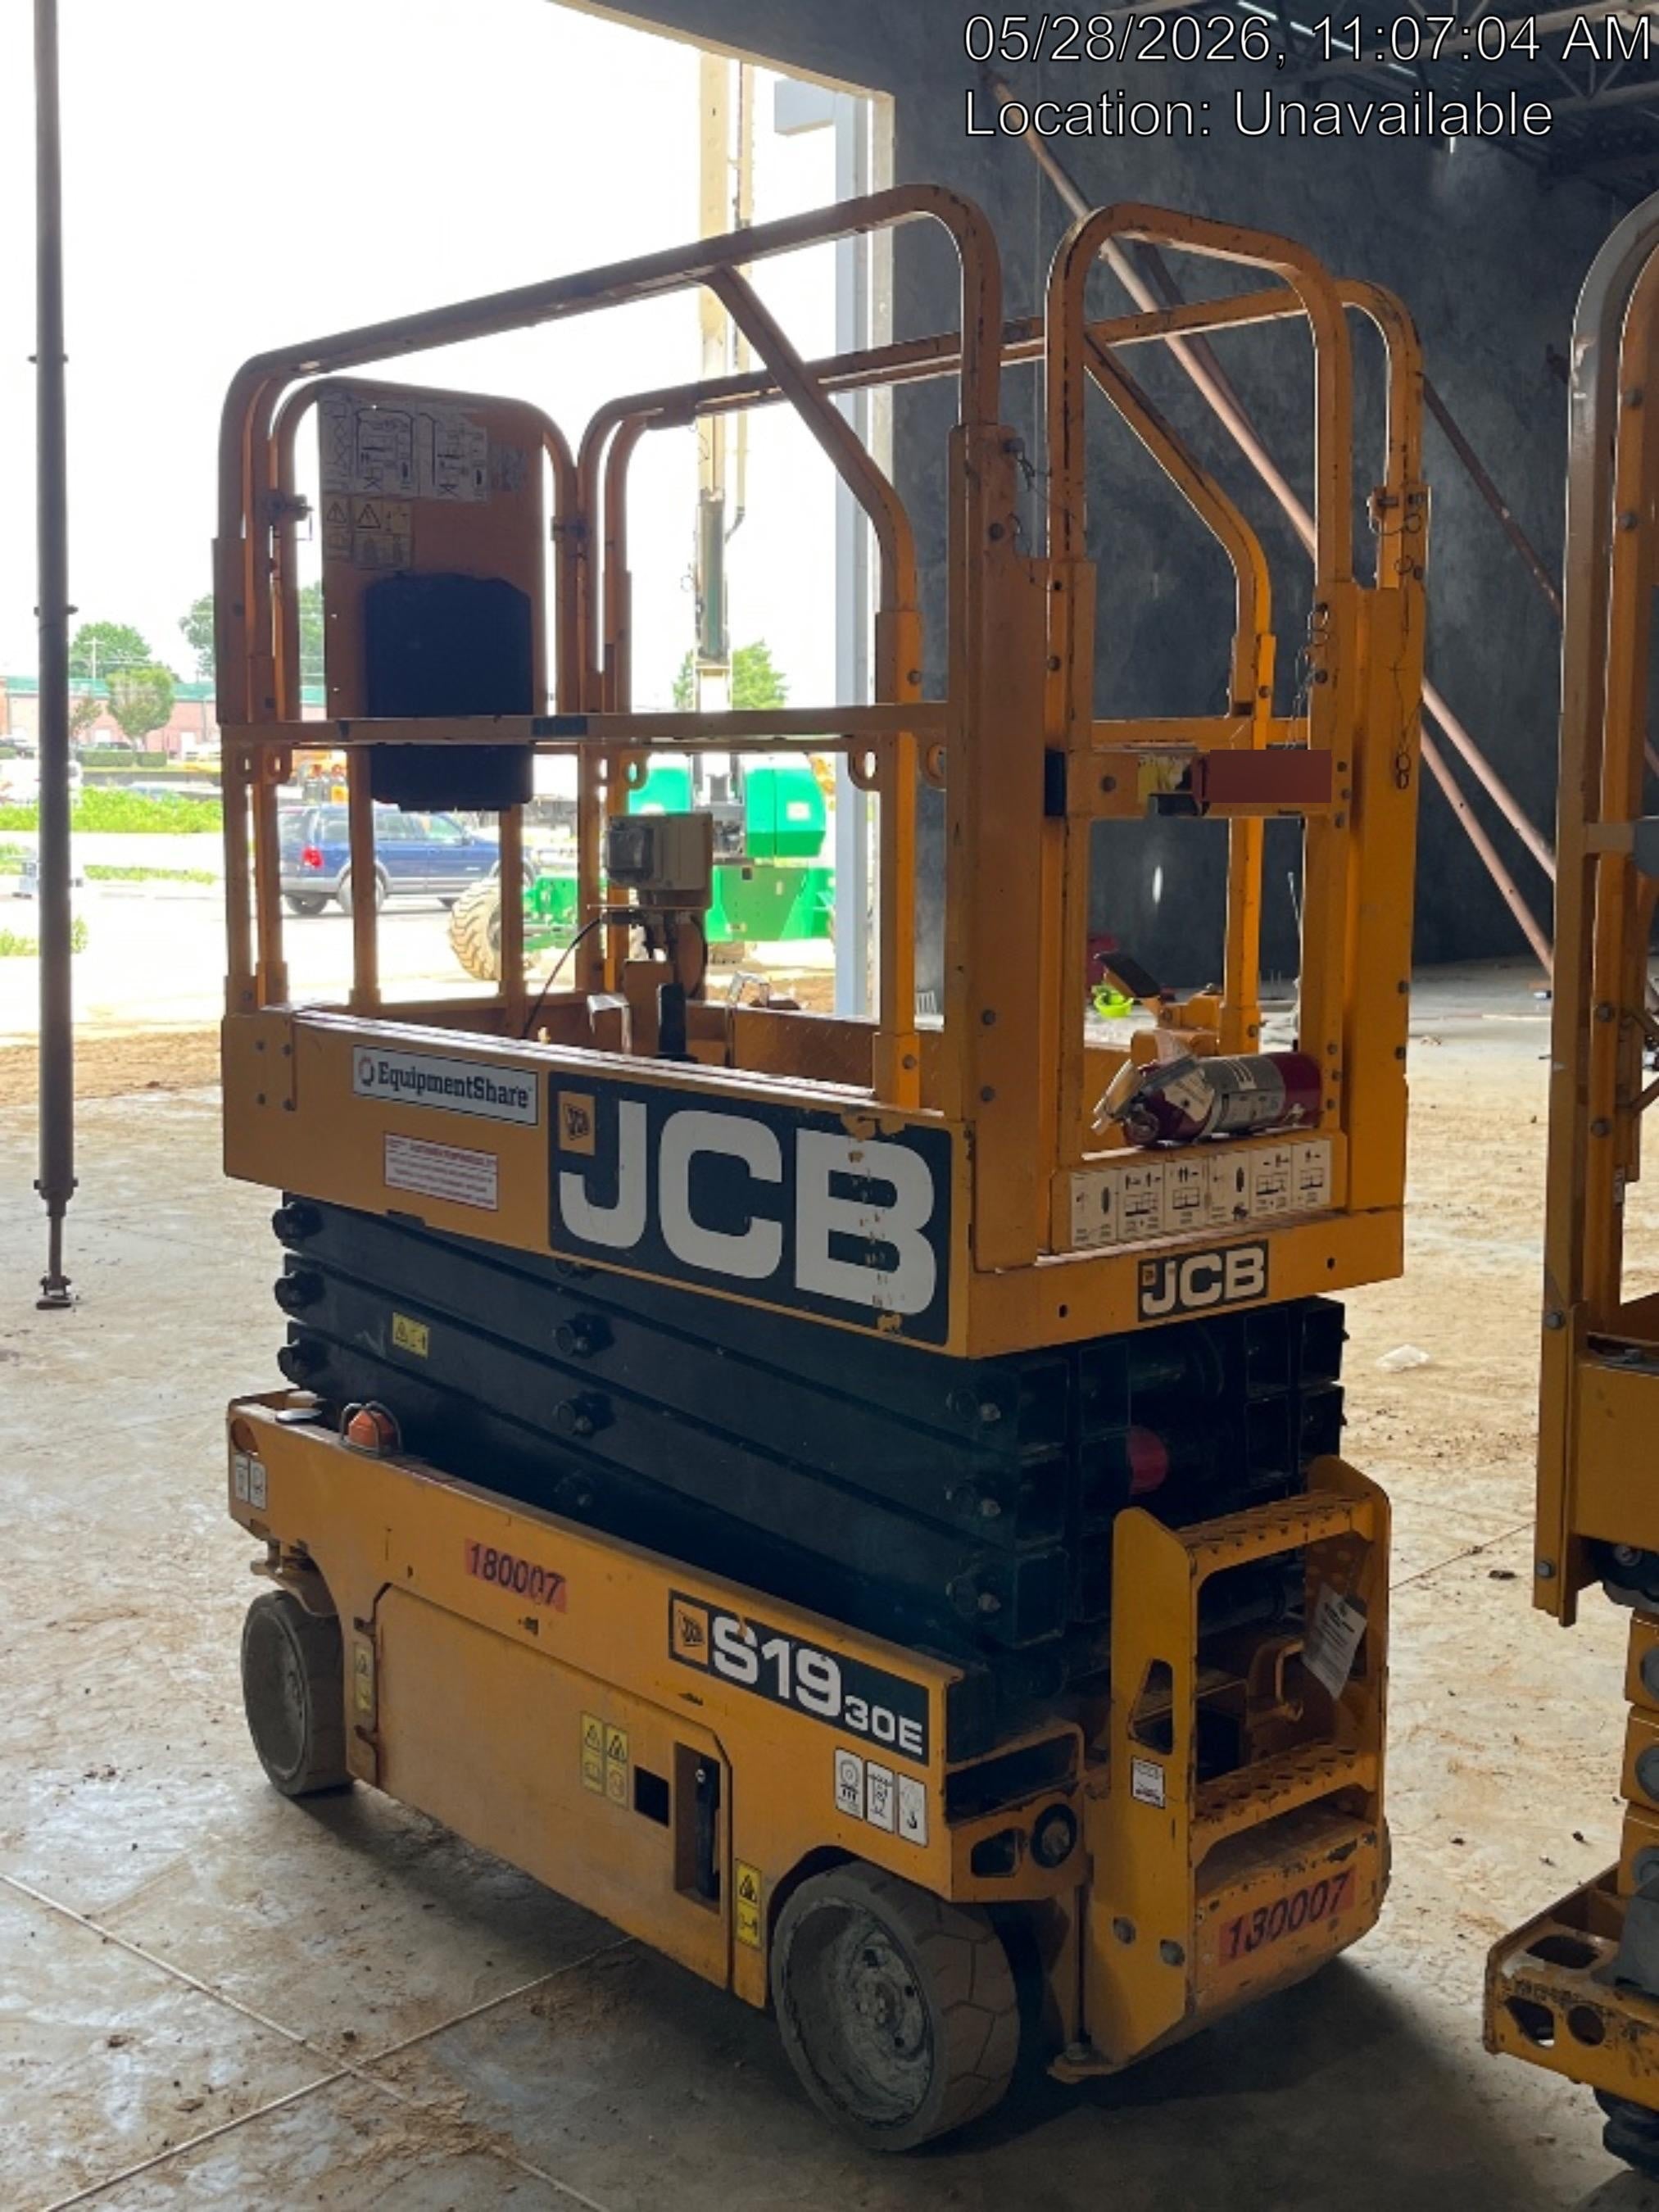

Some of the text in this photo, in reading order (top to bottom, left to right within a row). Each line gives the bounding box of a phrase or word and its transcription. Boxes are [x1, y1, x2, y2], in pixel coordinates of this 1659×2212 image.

[378, 1061, 529, 1108] EquipmentShare
[559, 1099, 937, 1315] JCB
[1141, 1248, 1265, 1316] JCB
[712, 1616, 841, 1717] S19
[844, 1694, 923, 1756] 30E
